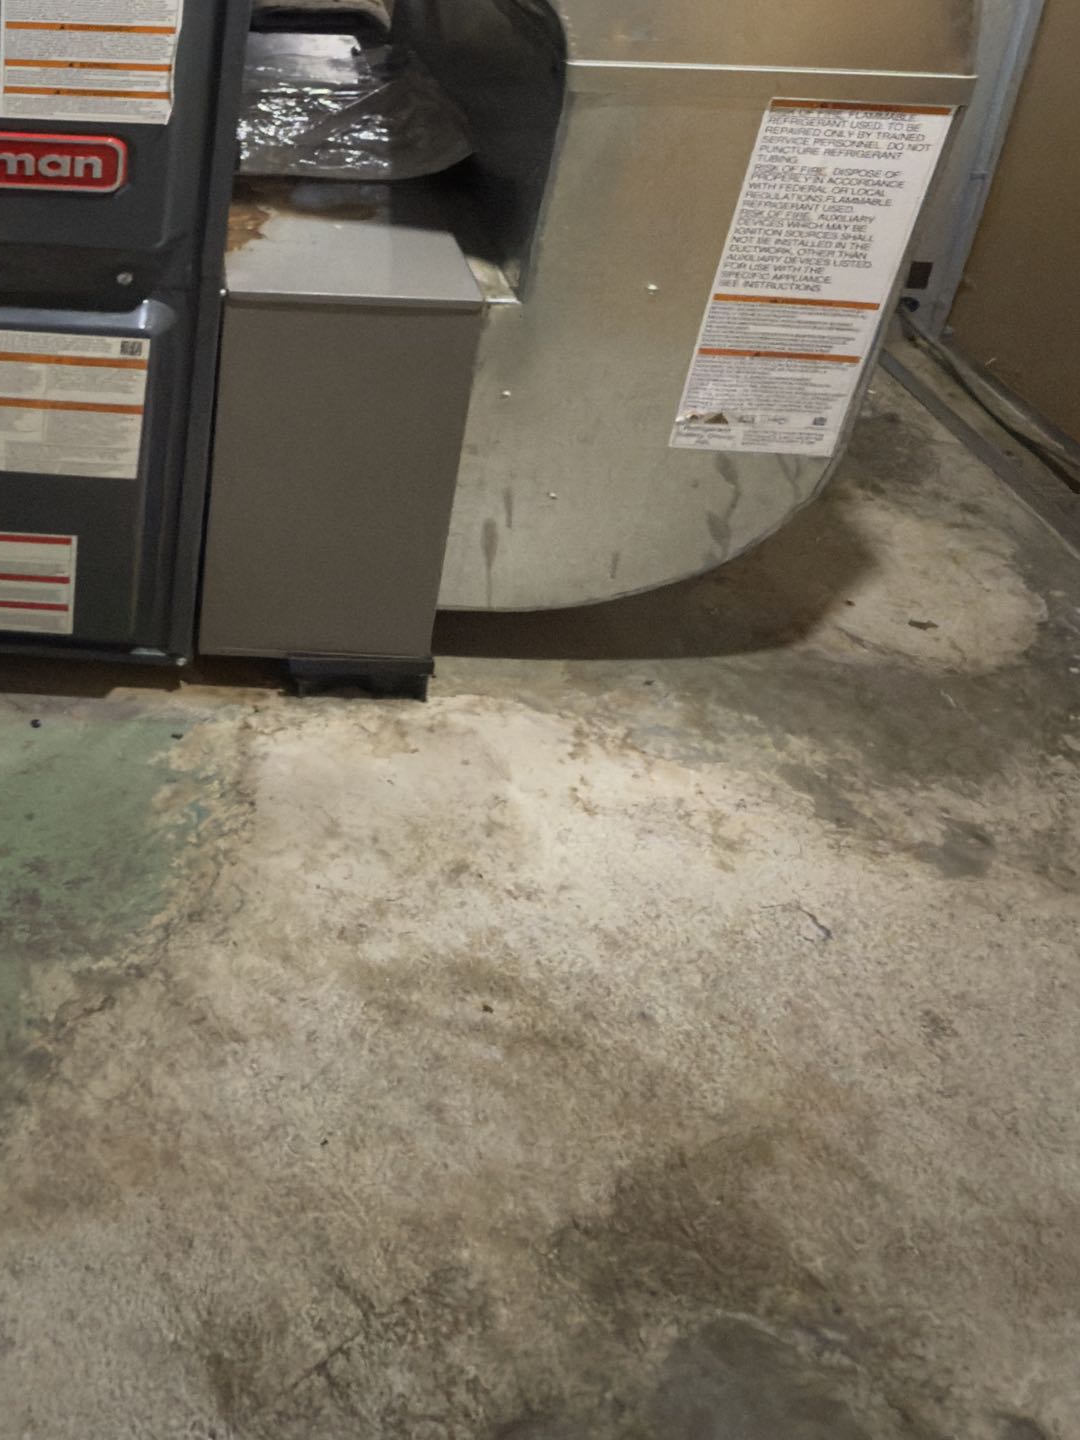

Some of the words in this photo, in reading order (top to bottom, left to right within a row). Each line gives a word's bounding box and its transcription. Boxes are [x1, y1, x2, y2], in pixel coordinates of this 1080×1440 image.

[888, 122, 903, 131] TO
[906, 123, 922, 133] BE
[765, 125, 821, 137] REPAIRED
[824, 128, 854, 138] ONLY
[857, 130, 872, 139] BY
[876, 132, 926, 143] TRAINED
[762, 135, 810, 146] SERVICE
[887, 142, 905, 151] DO
[907, 143, 931, 153] NOT
[759, 144, 820, 155] PUNCTURE
[824, 148, 902, 160] REFRIGERANT
[833, 168, 882, 178] DISPOSE
[885, 171, 902, 179] OF
[828, 176, 906, 188] ACCORDANCE
[748, 182, 776, 190] WITH
[780, 183, 828, 193] FEDERAL
[832, 186, 849, 194] OR
[852, 188, 887, 197] LOCAL
[853, 224, 868, 232] BE
[775, 238, 833, 248] INSTALLED
[850, 242, 872, 250] THE
